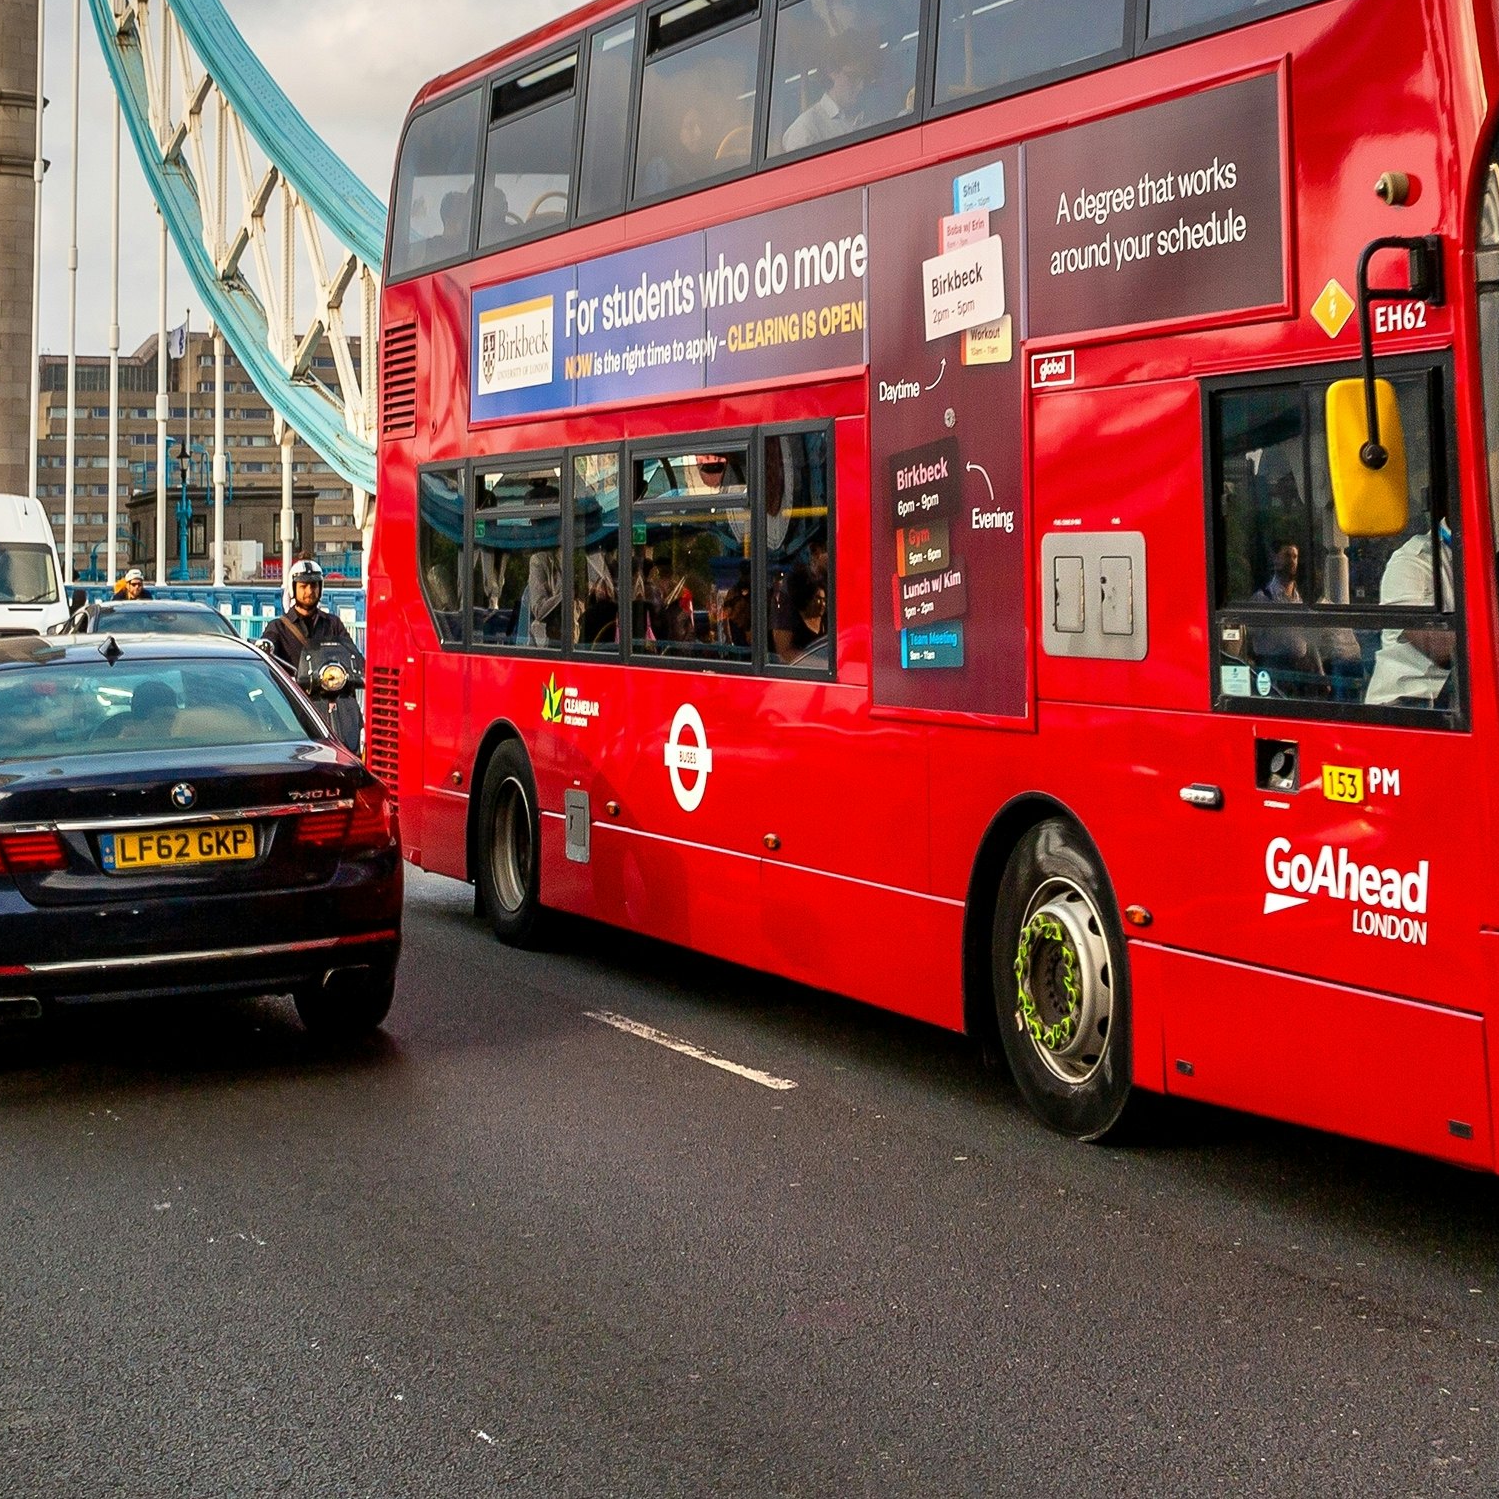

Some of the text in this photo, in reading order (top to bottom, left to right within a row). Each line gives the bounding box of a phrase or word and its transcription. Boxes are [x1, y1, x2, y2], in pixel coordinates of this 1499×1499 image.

[963, 180, 980, 198] Shift
[1056, 156, 1237, 225] A degree that works
[972, 219, 985, 231] Erin
[1050, 208, 1247, 276] around your schedule
[565, 233, 868, 337] For students who do more
[932, 262, 983, 298] Birkbeck
[932, 308, 950, 325] 2pm
[957, 300, 975, 316] 5pm
[1375, 301, 1426, 333] EH62
[498, 320, 548, 362] Birkbeck
[565, 352, 593, 380] NOW
[594, 352, 602, 375] is
[604, 349, 620, 374] the
[622, 346, 645, 375] right
[647, 341, 670, 367] time
[672, 338, 683, 361] to
[686, 330, 718, 364] apply
[727, 313, 799, 352] CLEARING
[802, 309, 816, 340] IS
[970, 327, 1000, 341] Workout
[1039, 357, 1065, 381] global
[879, 379, 920, 404] Daytime
[897, 457, 949, 491] Birkbeck
[897, 498, 915, 517] 6pm
[921, 492, 939, 512] 9pm
[972, 506, 1014, 533] Evening
[909, 528, 930, 548] Gym
[909, 552, 922, 566] 5pm
[927, 548, 941, 562] 6pm
[903, 570, 961, 599] Lunch w/ Kim
[904, 606, 916, 619] 1pm
[920, 601, 934, 615] 2pm
[910, 631, 958, 647] Team Meeting
[679, 751, 696, 764] BUSES
[1329, 771, 1357, 799] 153
[1368, 766, 1400, 796] PM
[120, 829, 248, 863] LF62 GKP
[1265, 837, 1429, 913] GoAhead
[1352, 908, 1427, 946] LONDON
